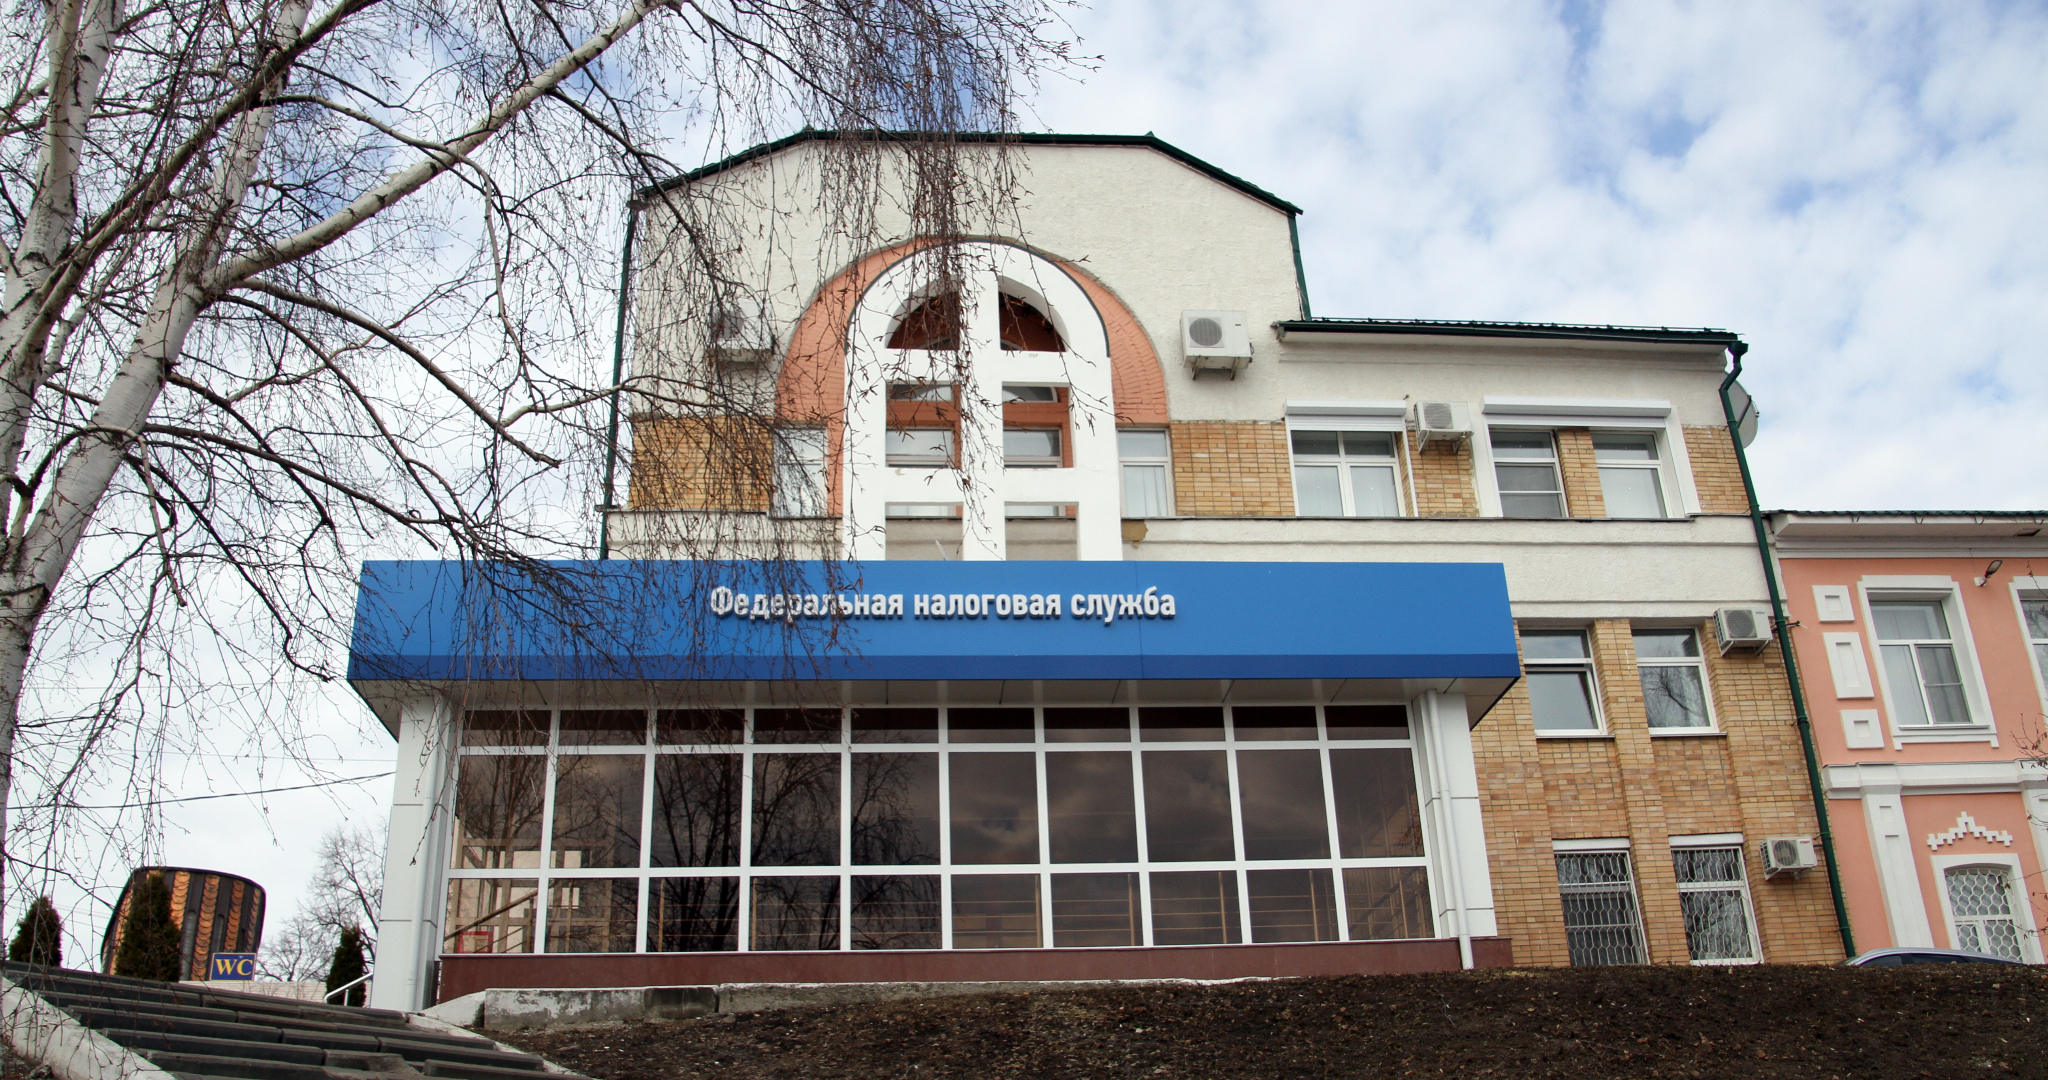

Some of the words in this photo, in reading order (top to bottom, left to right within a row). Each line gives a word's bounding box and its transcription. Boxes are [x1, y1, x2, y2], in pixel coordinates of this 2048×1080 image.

[710, 586, 904, 622] Федеральная
[914, 593, 1062, 617] налоговая
[1070, 585, 1177, 625] служба
[215, 958, 253, 976] WC
